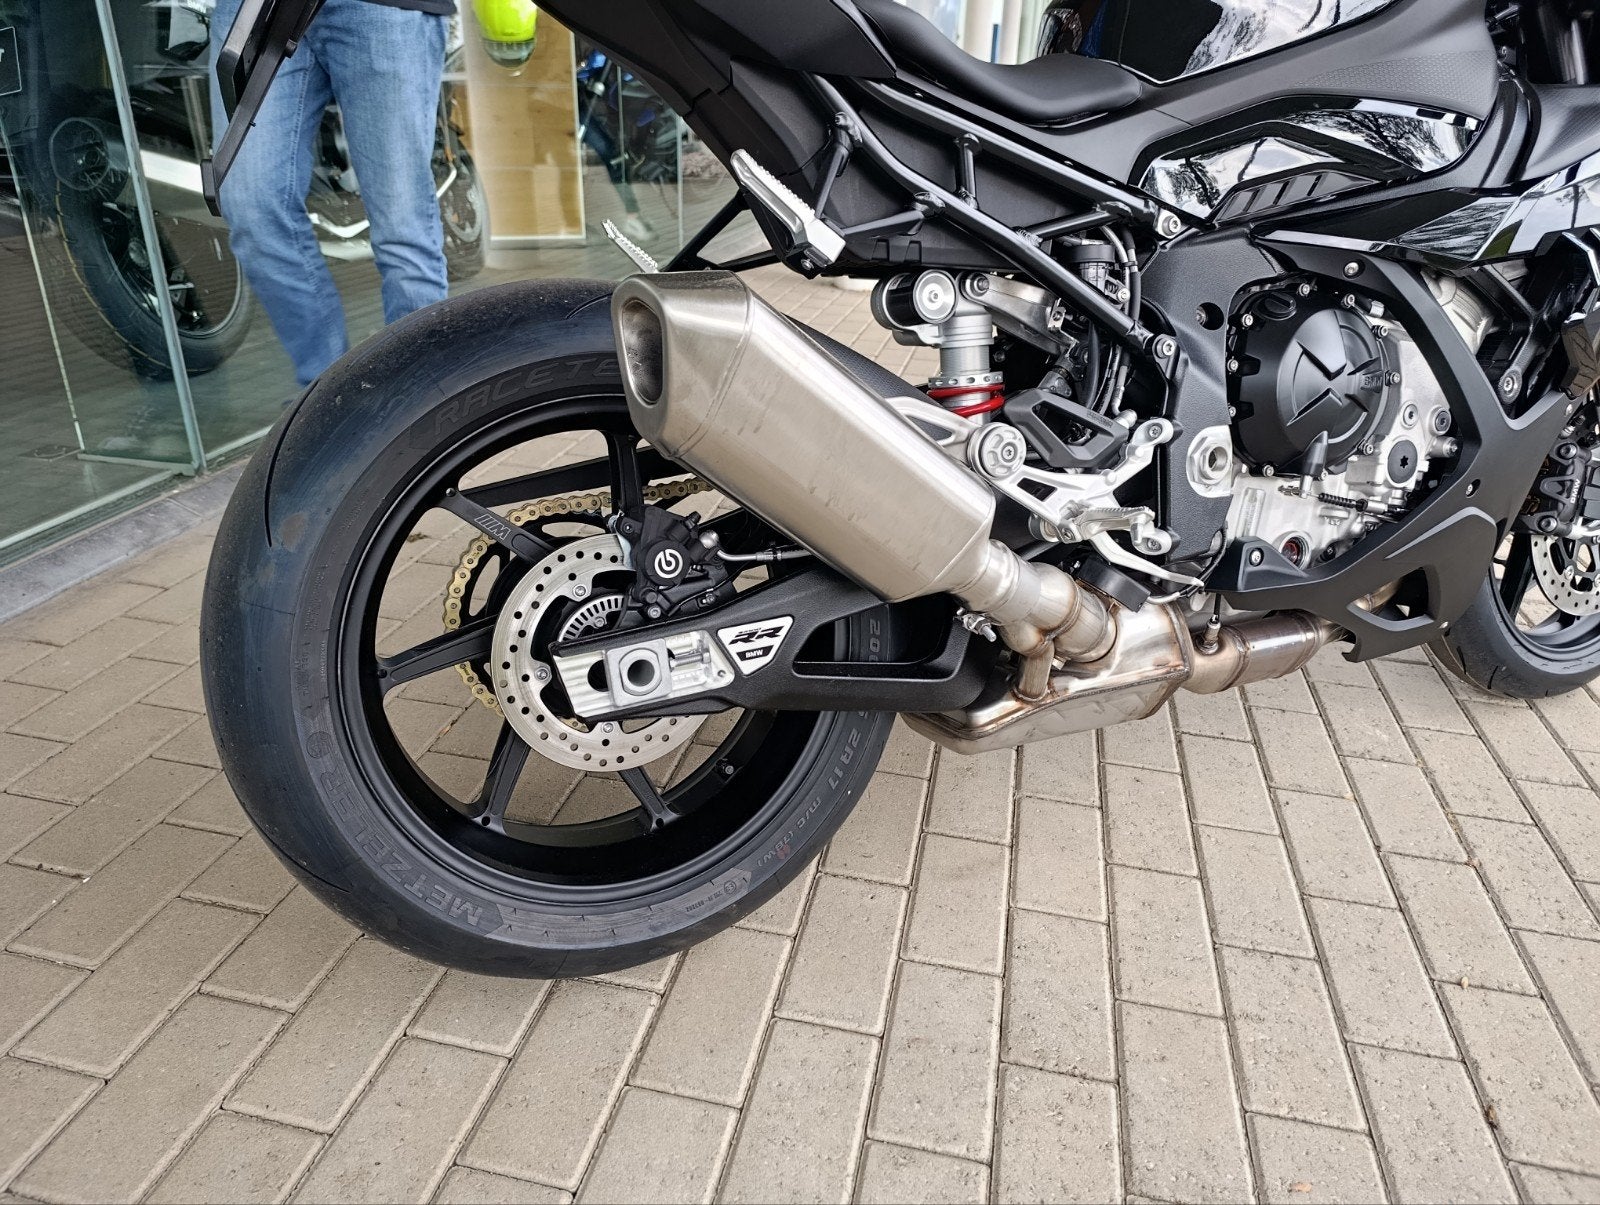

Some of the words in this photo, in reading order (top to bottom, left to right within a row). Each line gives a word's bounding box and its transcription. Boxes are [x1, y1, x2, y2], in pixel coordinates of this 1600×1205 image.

[1570, 478, 1581, 504] BMW
[745, 649, 764, 659] BMW
[320, 765, 484, 927] METZELER
